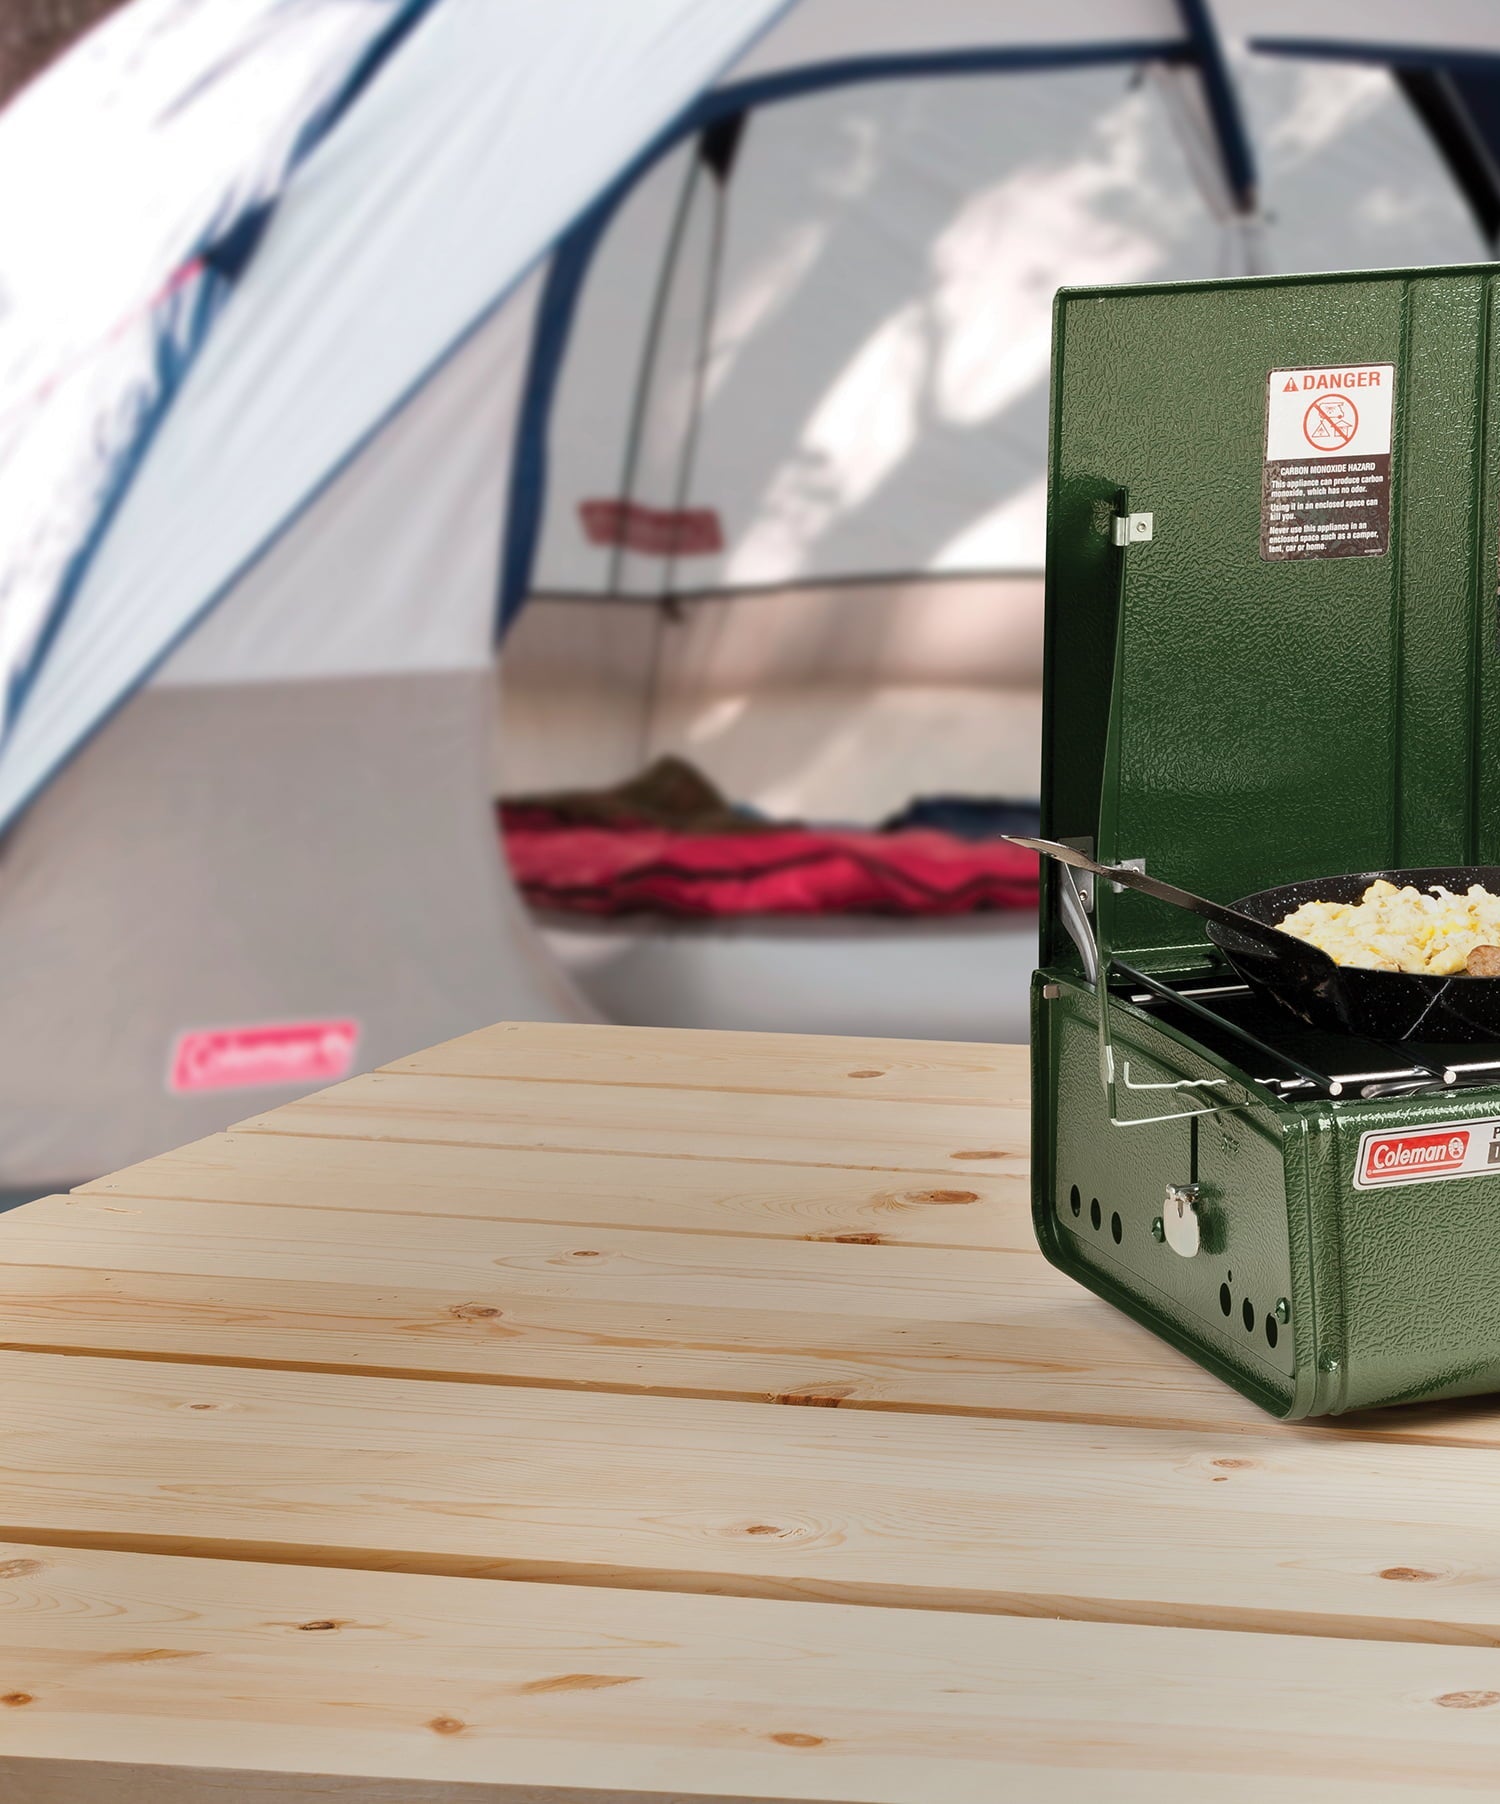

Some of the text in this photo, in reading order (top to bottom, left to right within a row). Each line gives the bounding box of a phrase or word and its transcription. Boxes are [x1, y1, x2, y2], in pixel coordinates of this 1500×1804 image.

[1303, 372, 1380, 390] DANGER
[1281, 463, 1375, 475] CARBON MONOXIDE HAZARD
[1287, 479, 1319, 489] appliance
[1334, 477, 1360, 486] produce
[1361, 475, 1383, 483] carbon
[1271, 489, 1305, 499] monoxide,
[1271, 503, 1289, 512] Using
[1291, 502, 1296, 510] it
[1315, 500, 1344, 508] enclosed
[1345, 500, 1365, 509] space
[1282, 513, 1296, 521] you.
[1270, 526, 1289, 534] Never
[1317, 523, 1349, 533] appliance
[1269, 535, 1298, 543] enclosed
[1300, 535, 1319, 543] space
[1321, 533, 1336, 541] such
[1352, 532, 1378, 541] camper,
[1269, 545, 1284, 554] tent,
[1374, 1143, 1448, 1168] Coleman
